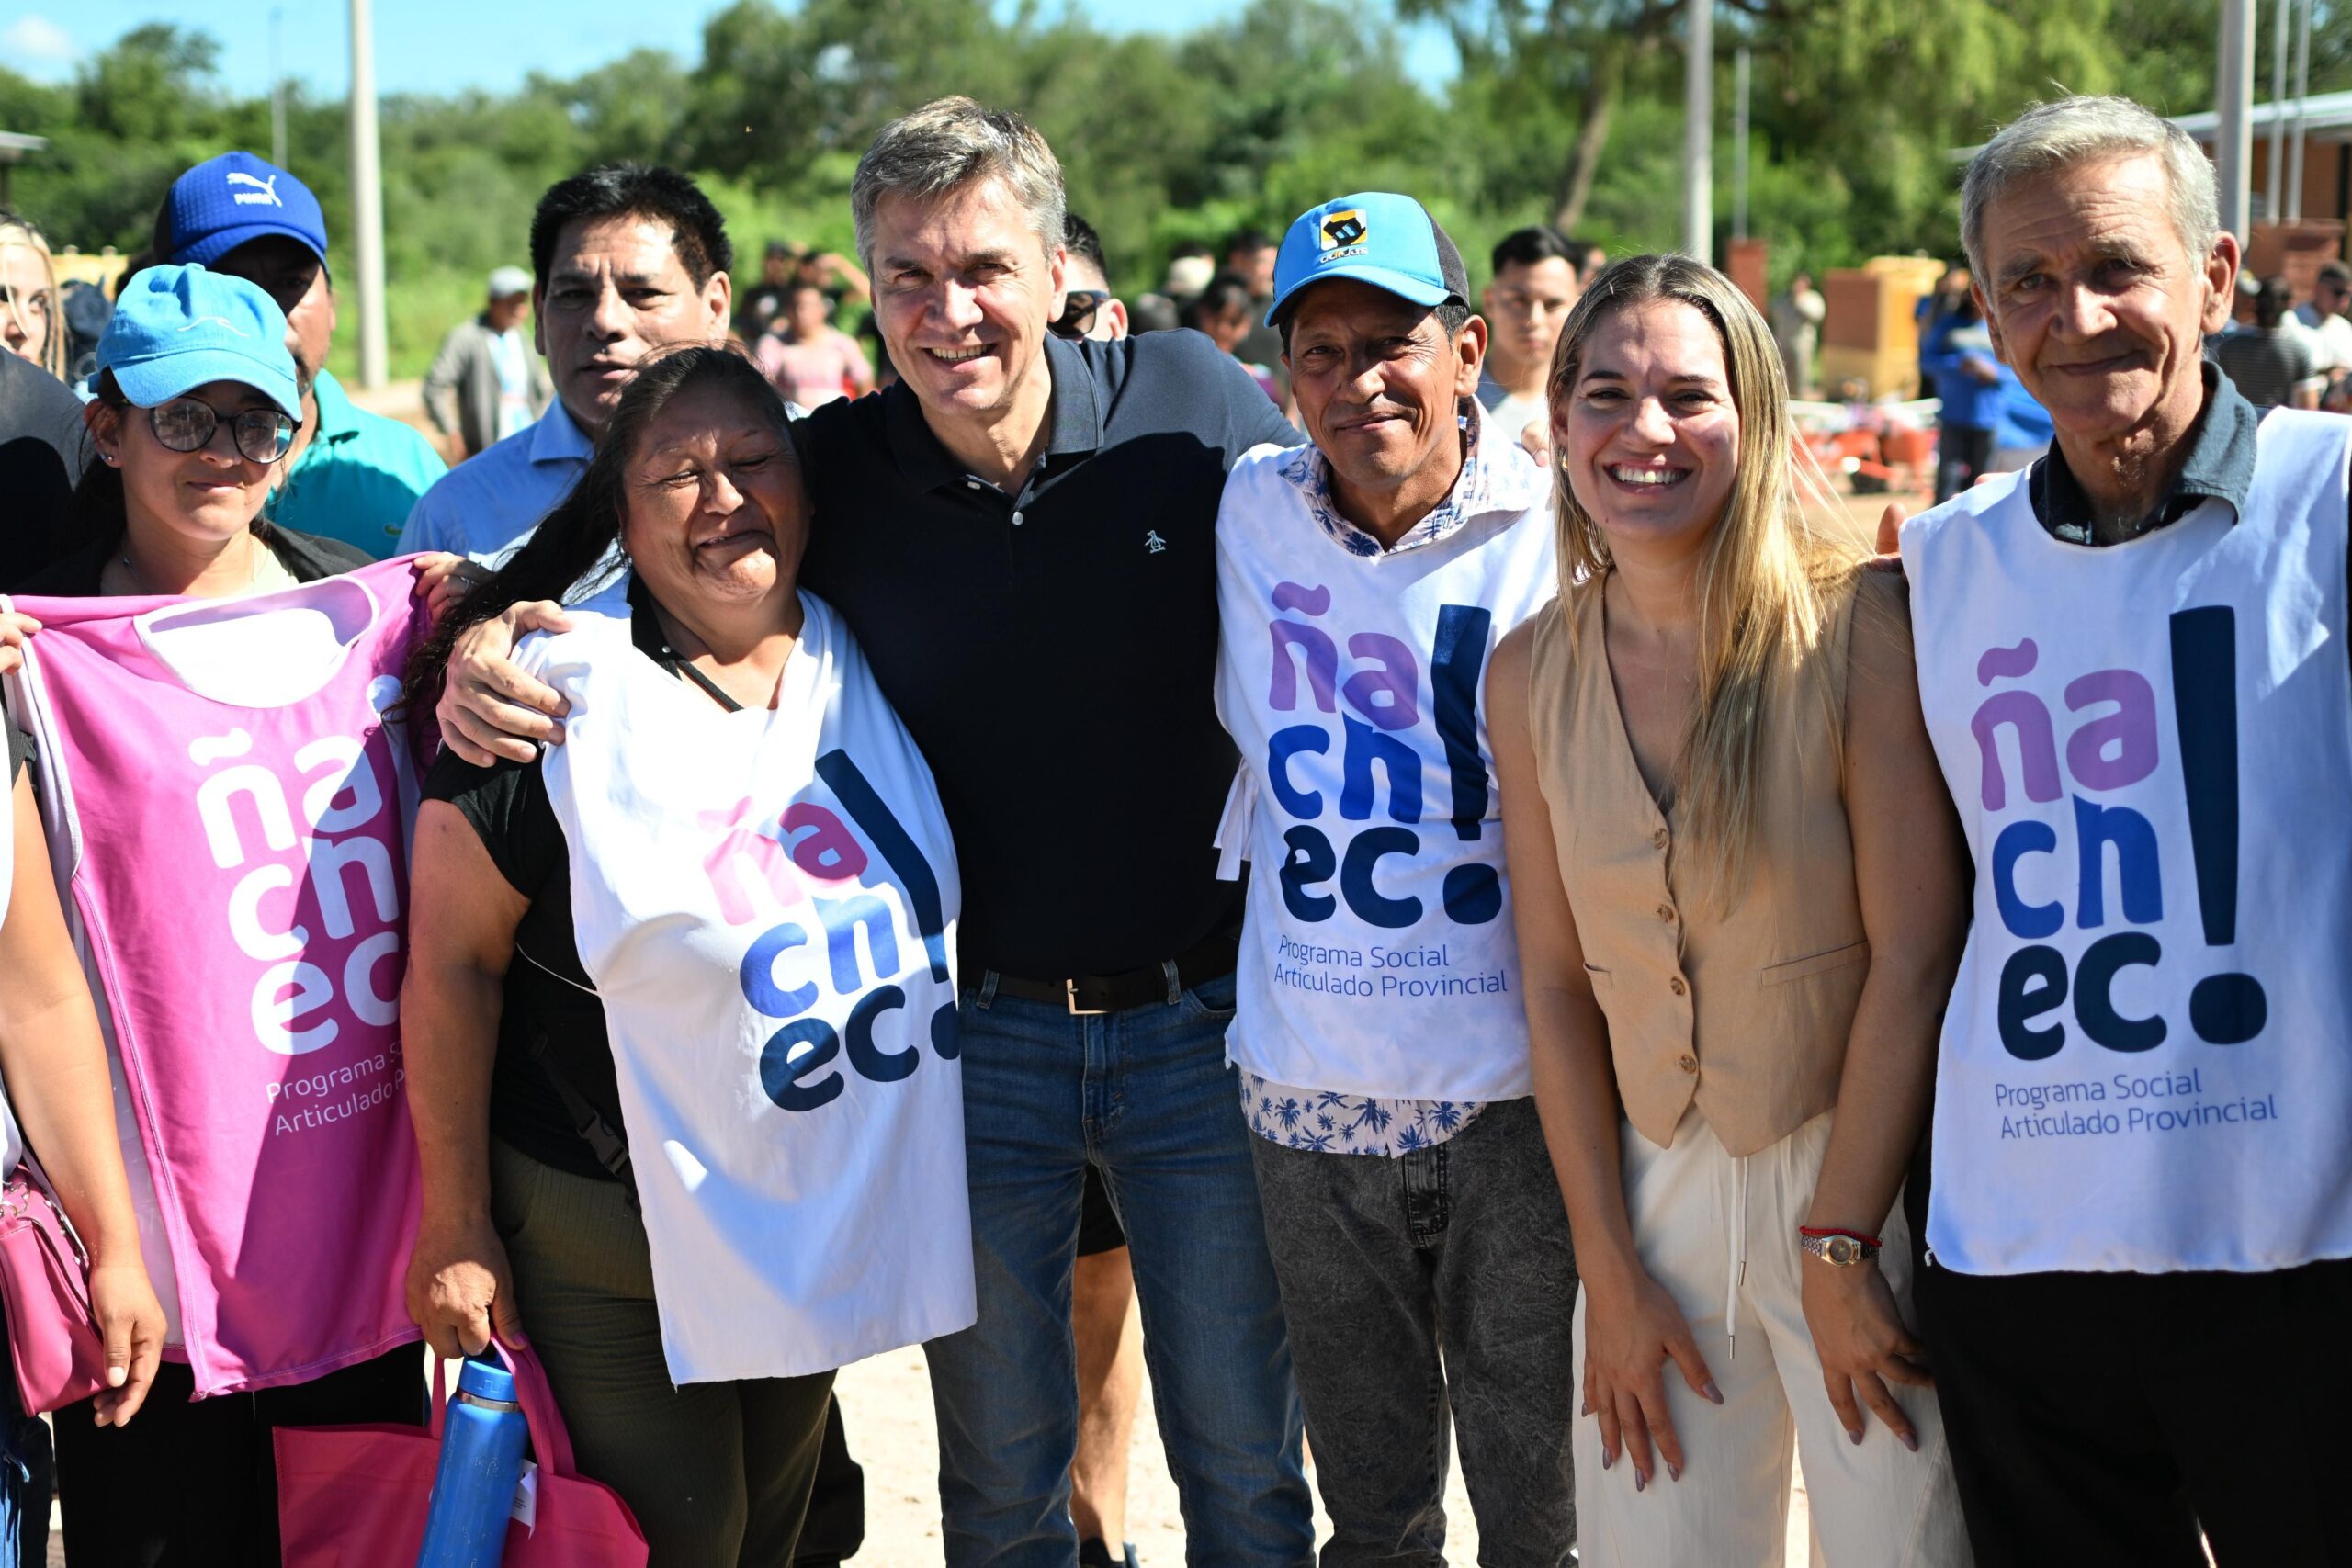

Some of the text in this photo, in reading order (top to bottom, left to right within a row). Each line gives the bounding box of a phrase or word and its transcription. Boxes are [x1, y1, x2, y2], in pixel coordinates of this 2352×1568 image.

[1319, 247, 1368, 264] adidas
[1269, 581, 1419, 731] ña
[1268, 710, 1423, 825] cn
[1971, 637, 2159, 811] ña
[188, 728, 382, 869] ña
[228, 834, 400, 961] cn
[1279, 824, 1423, 929] ec
[1992, 792, 2164, 940] cn
[740, 895, 901, 1019] cn
[1274, 963, 1508, 997] Articulado Provincial
[1278, 934, 1449, 969] Programa Social
[1997, 931, 2167, 1061] ec
[266, 1054, 386, 1104] Programa
[759, 984, 920, 1112] ec
[1995, 1067, 2202, 1110] Programa Social
[276, 1082, 393, 1136] Articulado
[2001, 1094, 2278, 1139] Articulado Provincial
